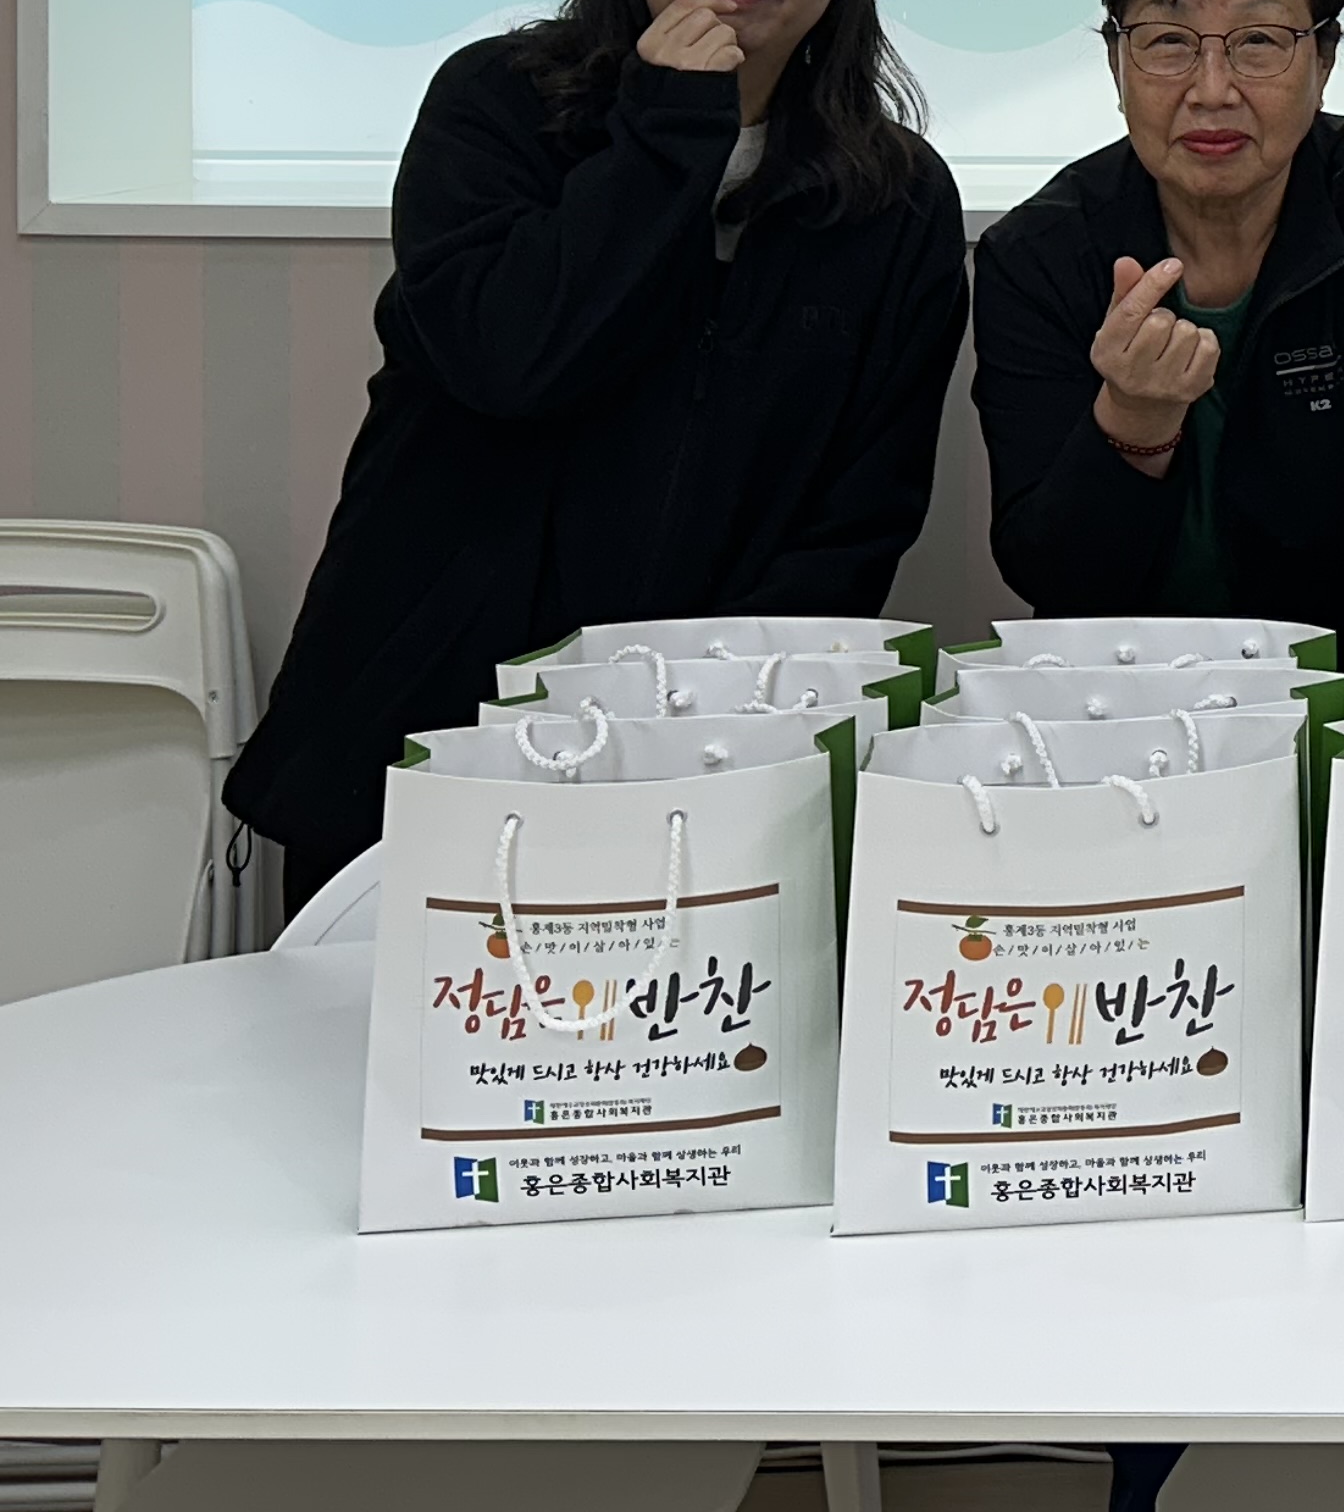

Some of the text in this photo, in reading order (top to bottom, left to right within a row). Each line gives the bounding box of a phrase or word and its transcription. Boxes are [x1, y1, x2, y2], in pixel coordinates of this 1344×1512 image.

[641, 916, 666, 931] 사업
[626, 956, 772, 1041] 반찬
[903, 958, 1235, 1046] 정담은 반찬
[470, 1051, 731, 1085] 맛있게 드시고 항상 건강하세요
[939, 1055, 1194, 1089] 맛있게 드시고 항상 건강하세요
[544, 1155, 566, 1168] 함께
[651, 1149, 672, 1162] 함께
[1014, 1160, 1036, 1172] 함께
[1119, 1154, 1139, 1167] 함께
[520, 1165, 731, 1197] 홍은종합사회복지관
[991, 1171, 1196, 1202] 홍은종합사회복지관
